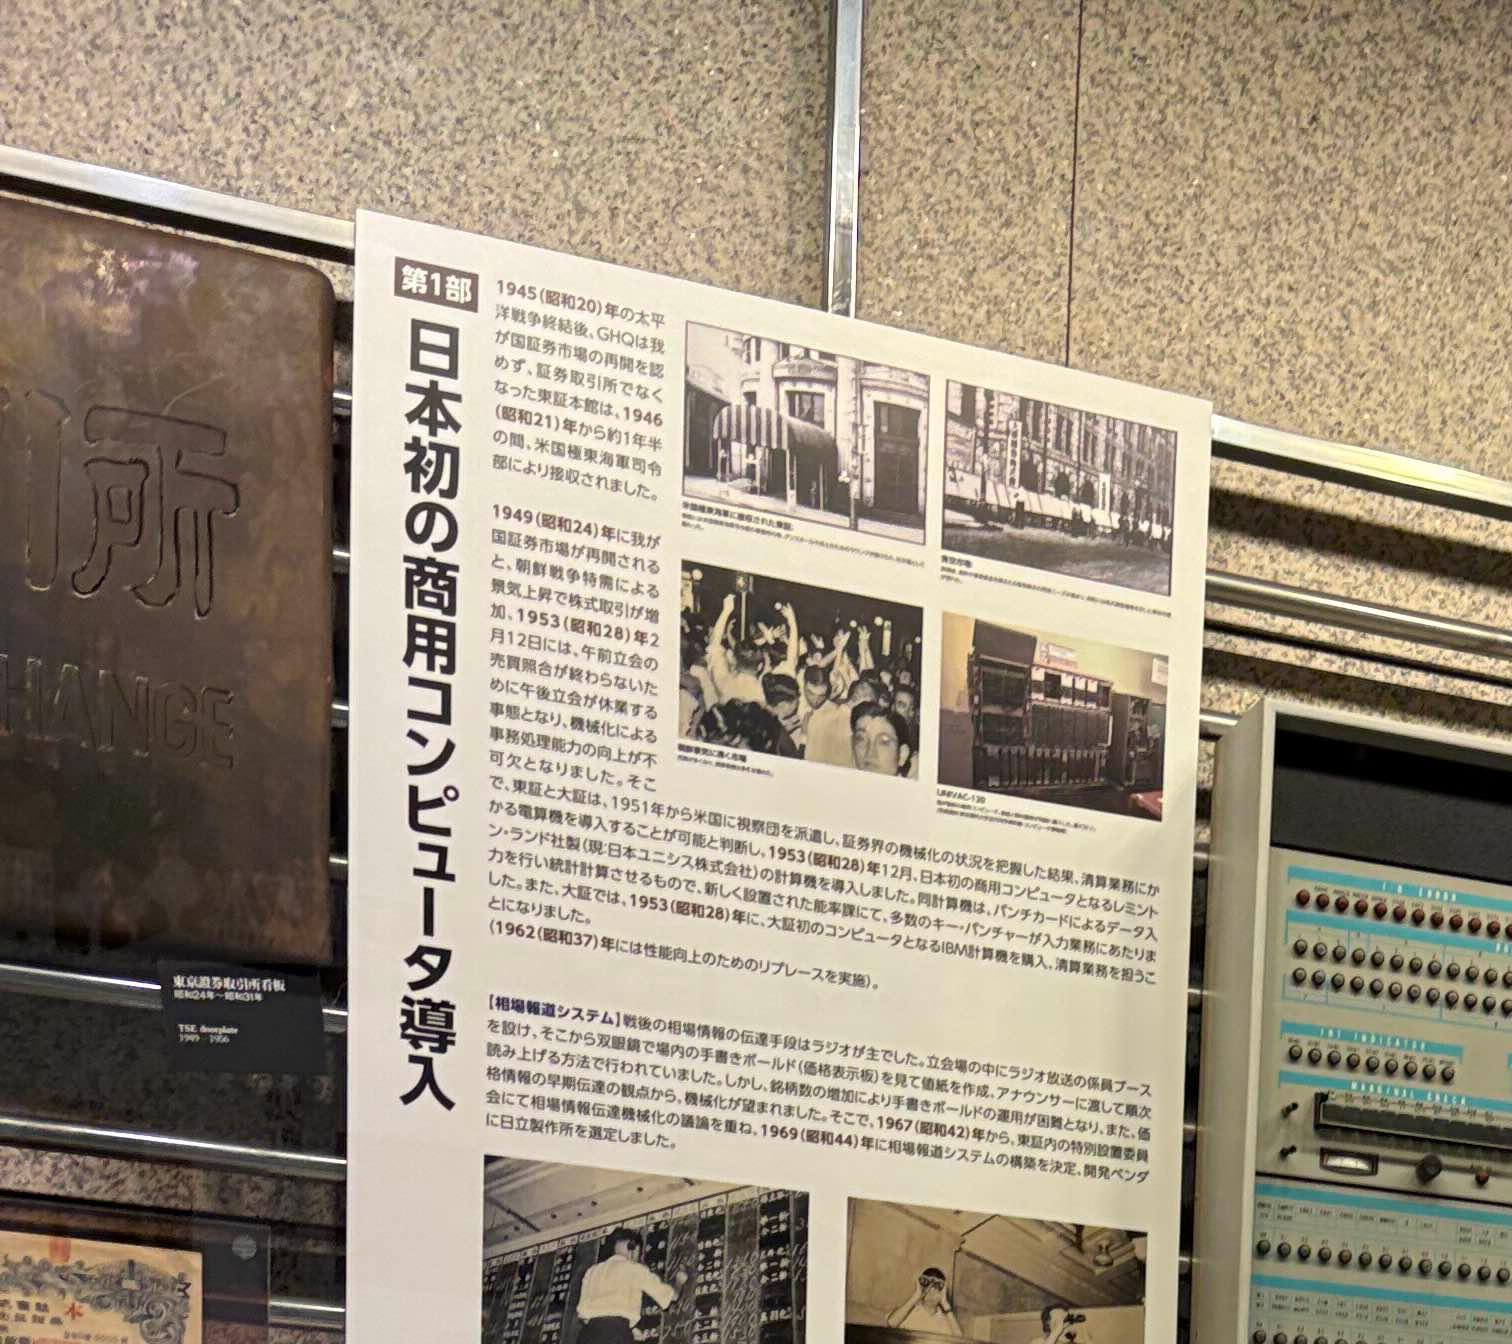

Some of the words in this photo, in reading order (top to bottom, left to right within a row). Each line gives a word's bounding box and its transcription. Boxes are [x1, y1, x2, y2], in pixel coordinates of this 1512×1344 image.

[400, 263, 474, 306] 第1部
[399, 318, 462, 1111] 日本初の商用コンピュータ導入
